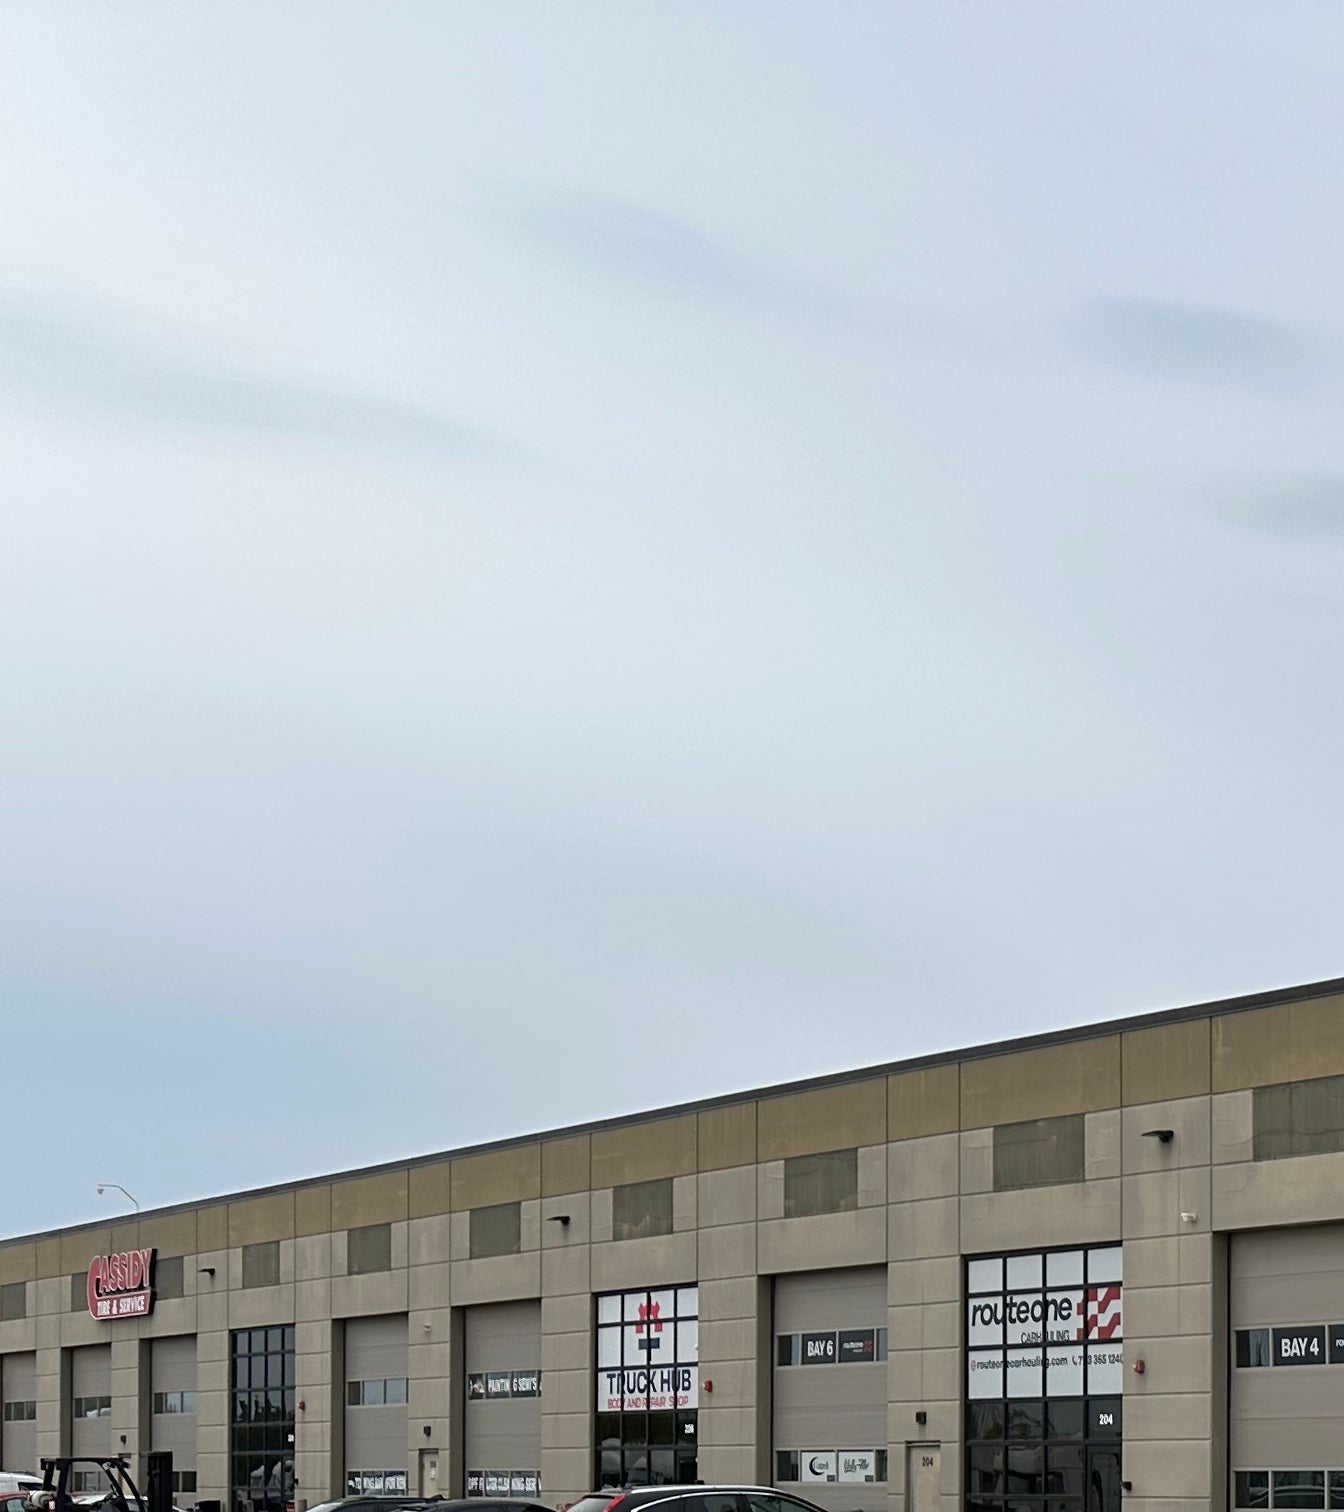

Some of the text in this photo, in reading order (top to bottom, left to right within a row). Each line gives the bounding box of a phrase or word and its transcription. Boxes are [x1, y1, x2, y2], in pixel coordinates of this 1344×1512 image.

[87, 1248, 152, 1318] CASSIDY
[119, 1296, 145, 1313] SERVICE
[972, 1296, 1072, 1327] routeone
[807, 1340, 834, 1357] BAY 6
[1281, 1337, 1320, 1357] BAY 4
[606, 1369, 691, 1395] TRUCK HUB
[642, 1396, 666, 1408] RPAIR
[669, 1396, 689, 1407] SOP
[1100, 1414, 1113, 1425] 204
[922, 1456, 933, 1467] 204
